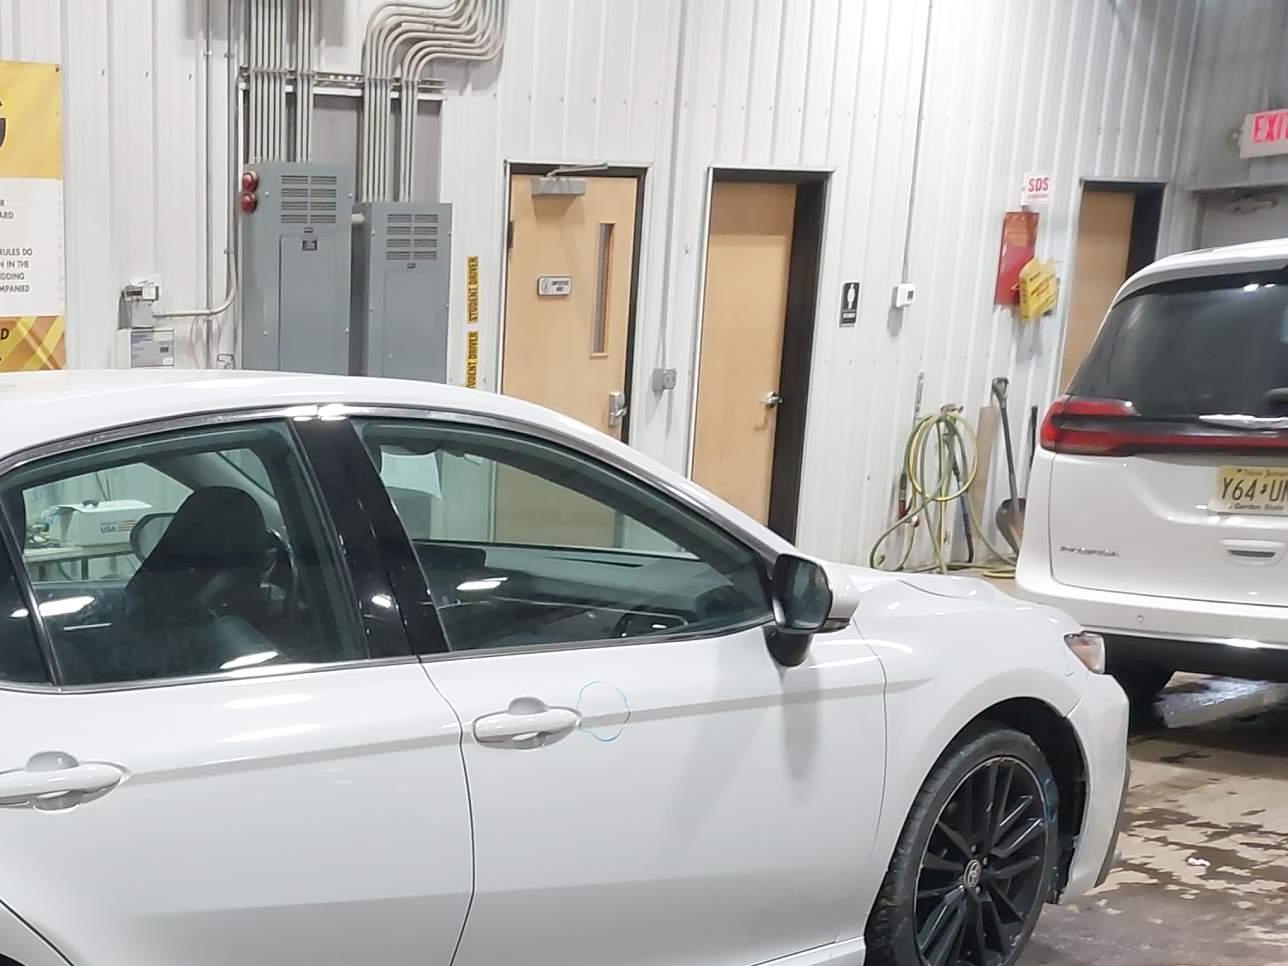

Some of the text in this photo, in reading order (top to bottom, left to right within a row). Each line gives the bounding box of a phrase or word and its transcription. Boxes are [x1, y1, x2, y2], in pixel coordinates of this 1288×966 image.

[1253, 112, 1288, 144] EXI
[1028, 177, 1050, 193] SDS
[22, 248, 33, 256] DO
[6, 261, 15, 269] IN
[17, 260, 30, 268] THE
